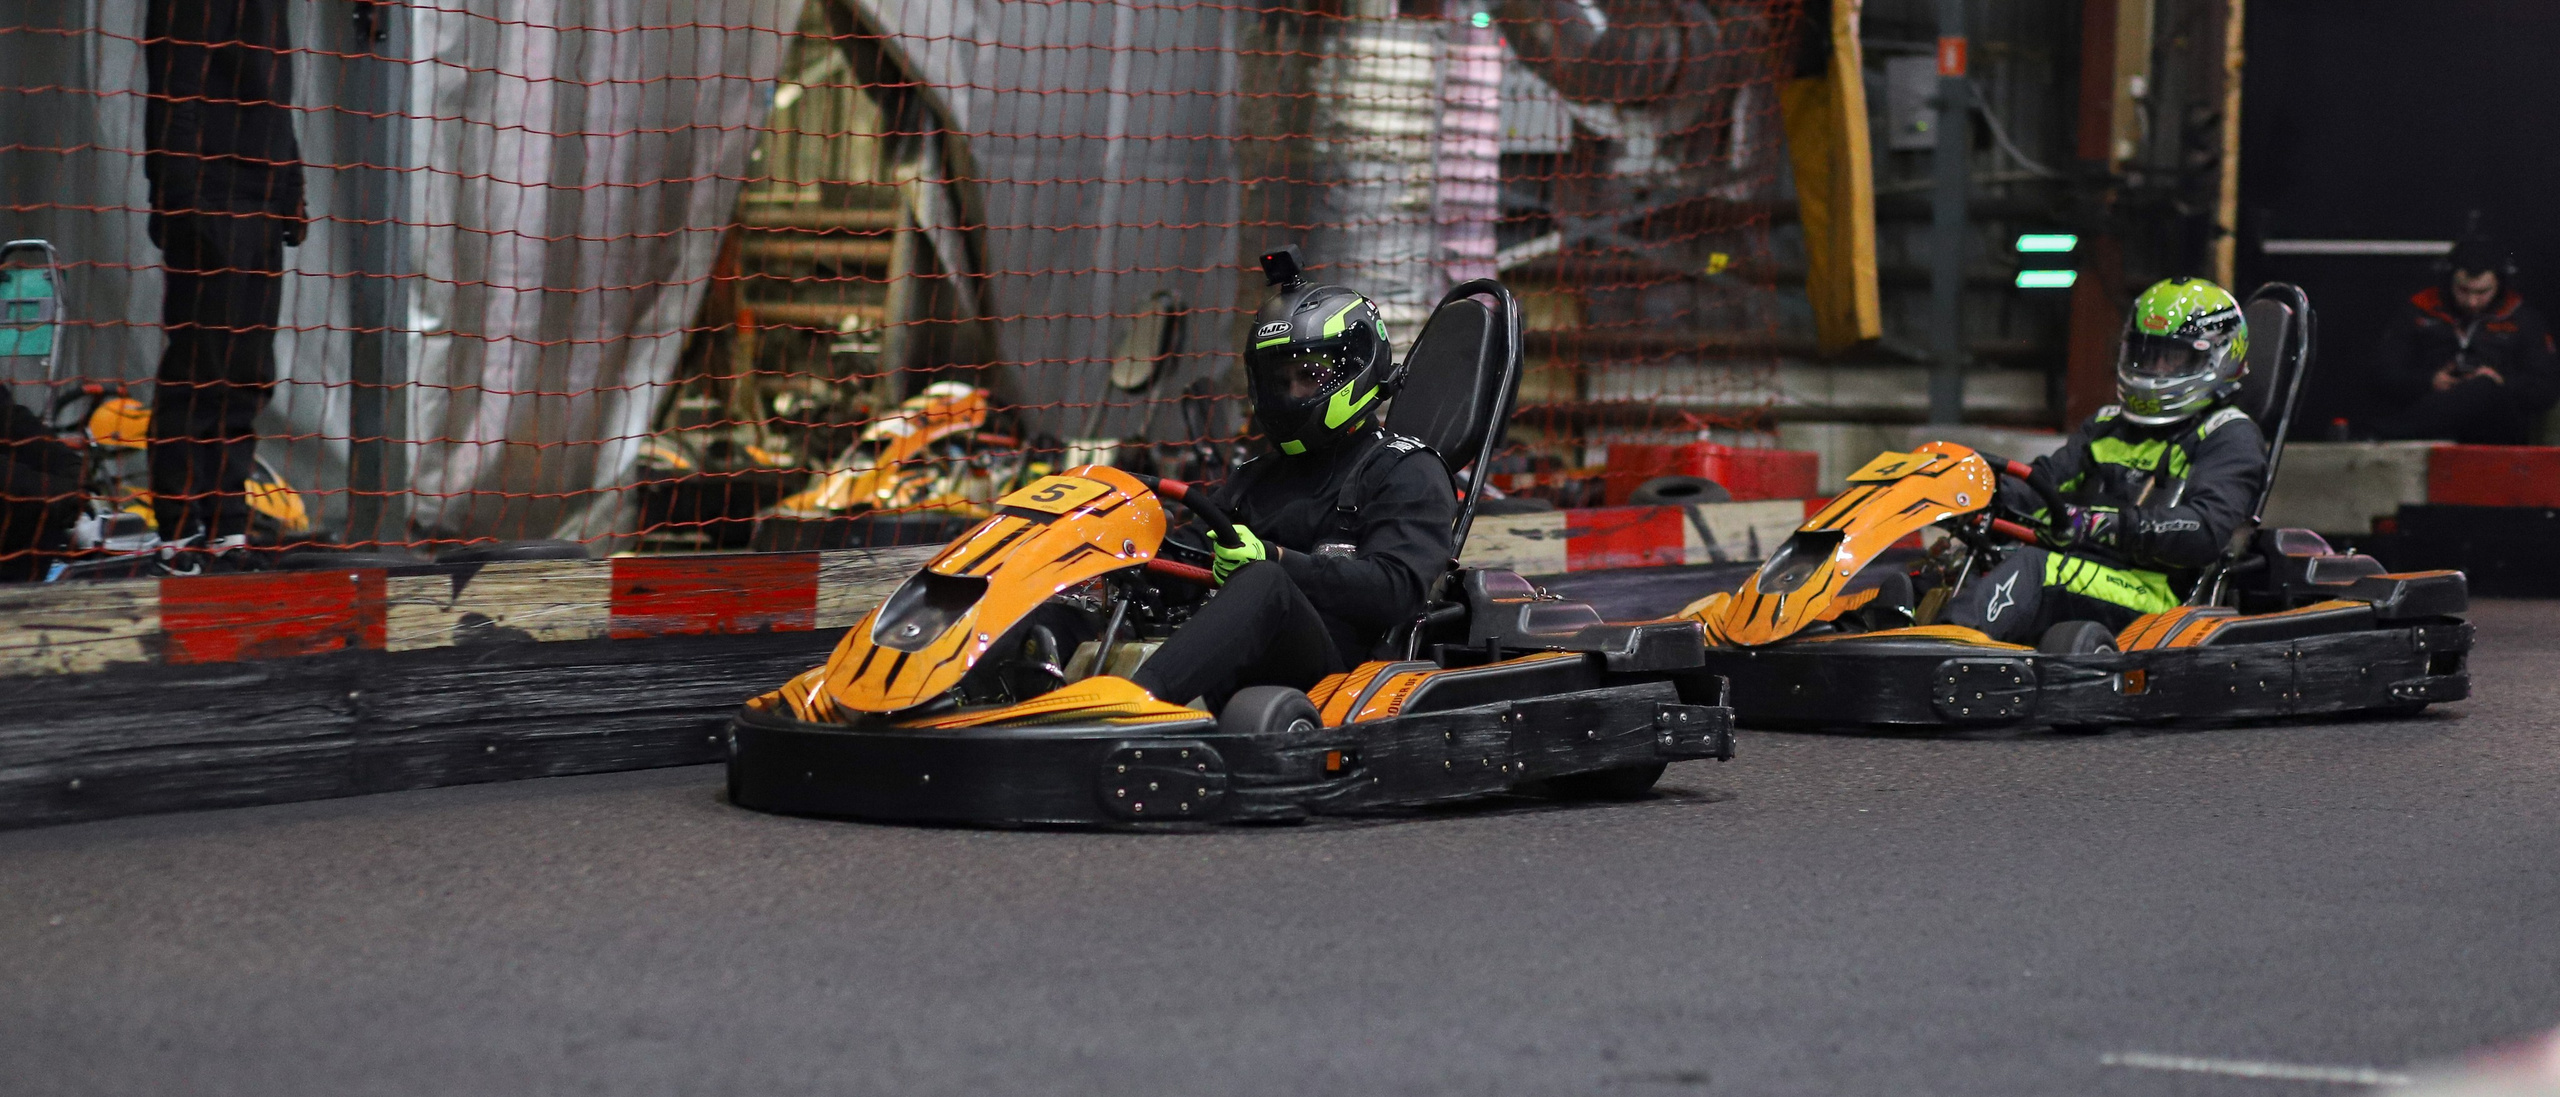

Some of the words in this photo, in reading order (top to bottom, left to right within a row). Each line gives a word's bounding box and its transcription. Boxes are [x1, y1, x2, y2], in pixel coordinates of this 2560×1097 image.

[1259, 323, 1288, 336] HJC
[1874, 461, 1908, 476] 4
[1030, 483, 1078, 503] 5
